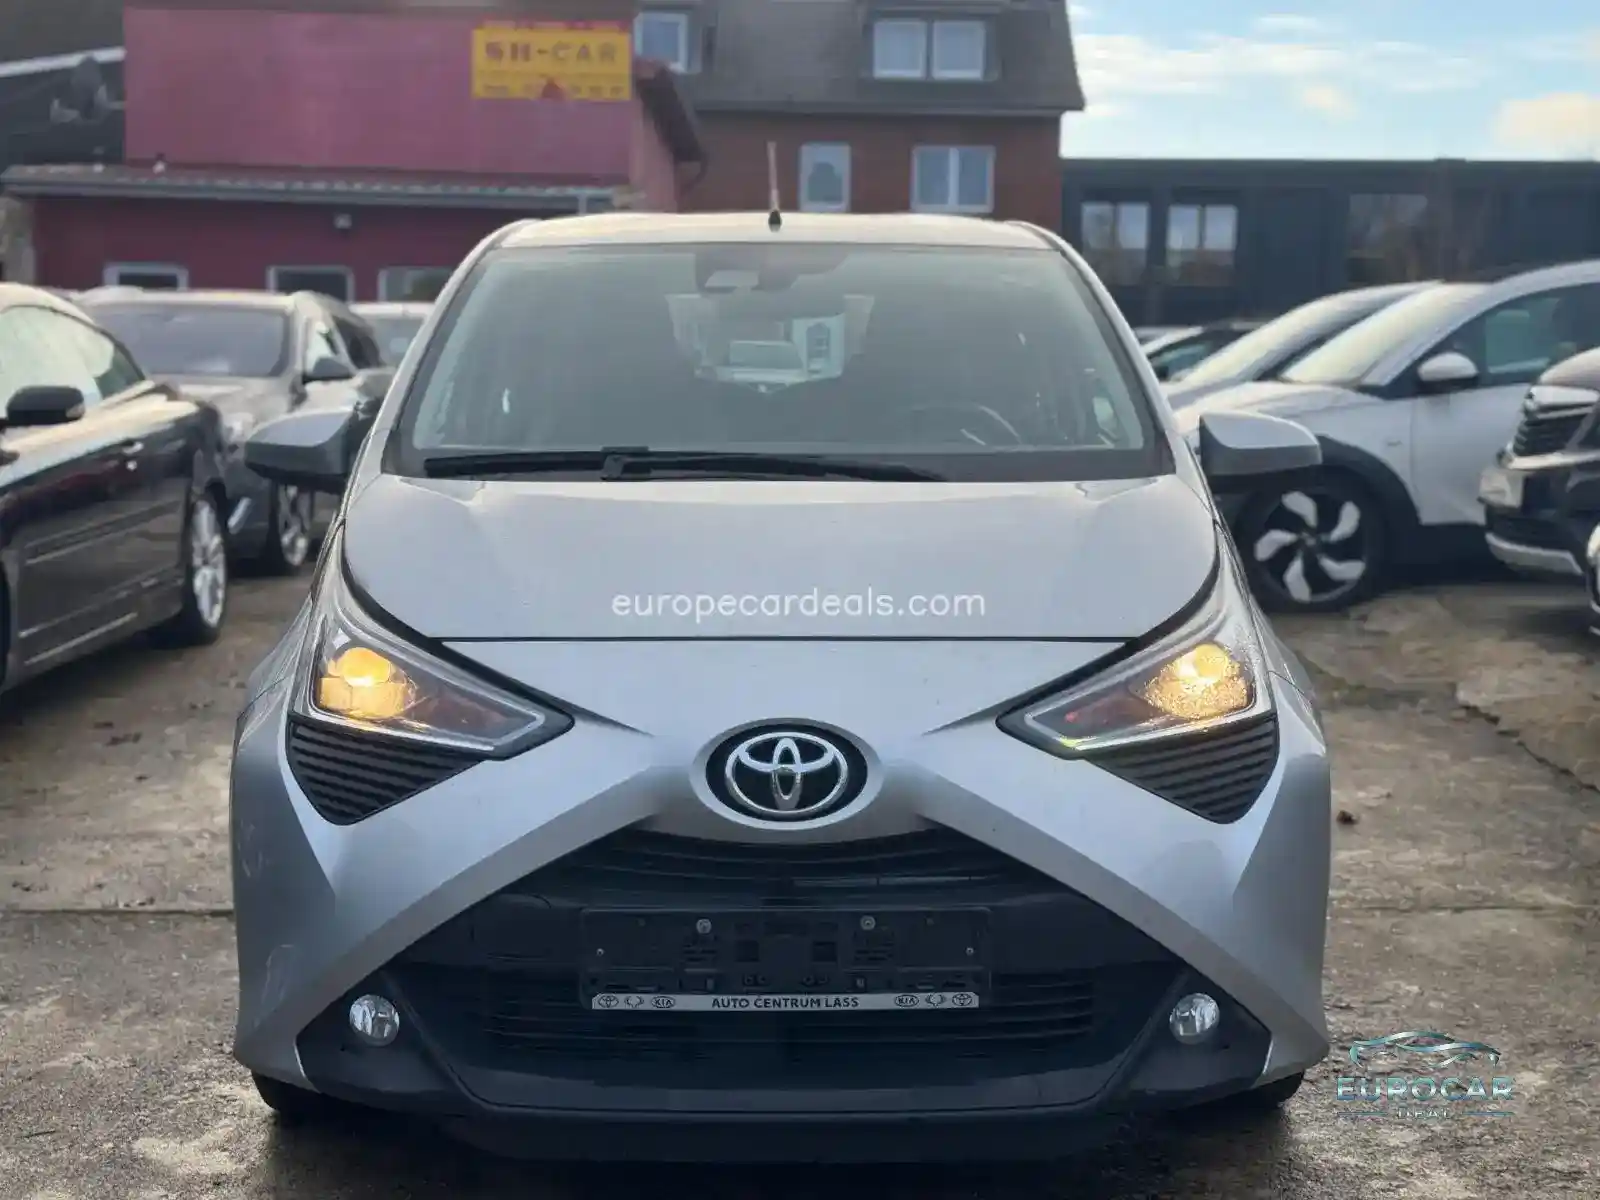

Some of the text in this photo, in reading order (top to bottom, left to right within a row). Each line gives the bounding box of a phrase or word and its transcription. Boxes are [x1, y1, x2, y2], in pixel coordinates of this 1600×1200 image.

[711, 996, 860, 1009] AUTO CENTRUM LASS
